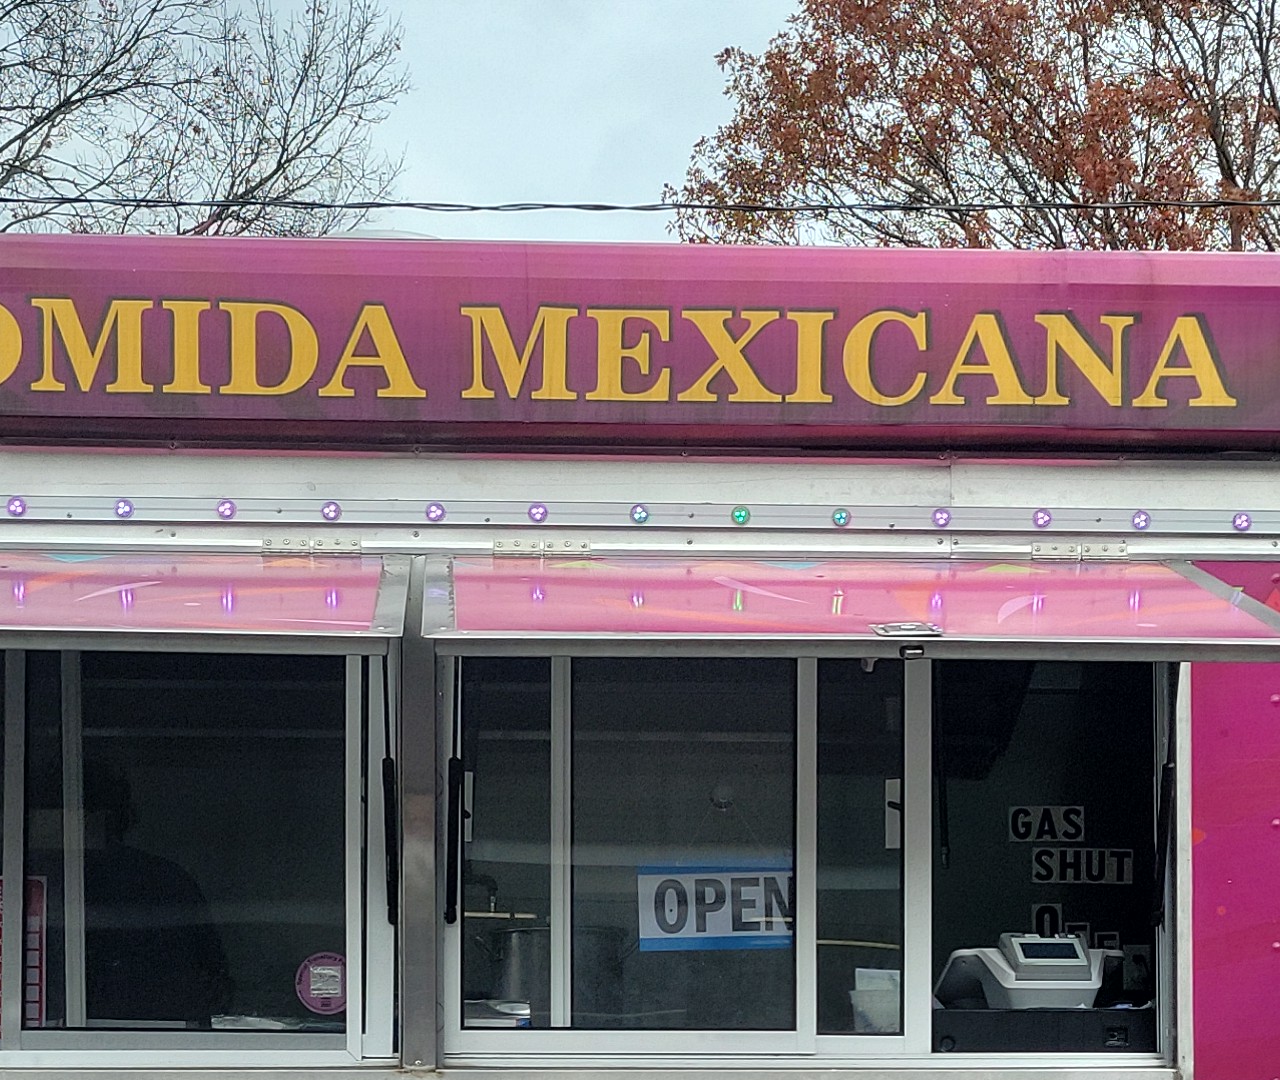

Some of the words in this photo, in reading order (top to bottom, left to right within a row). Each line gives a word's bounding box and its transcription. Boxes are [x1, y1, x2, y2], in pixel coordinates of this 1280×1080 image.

[460, 306, 1237, 408] MEXICANA
[1011, 808, 1083, 839] GAS
[1034, 849, 1131, 882] SHUT
[652, 876, 794, 935] OPEN
